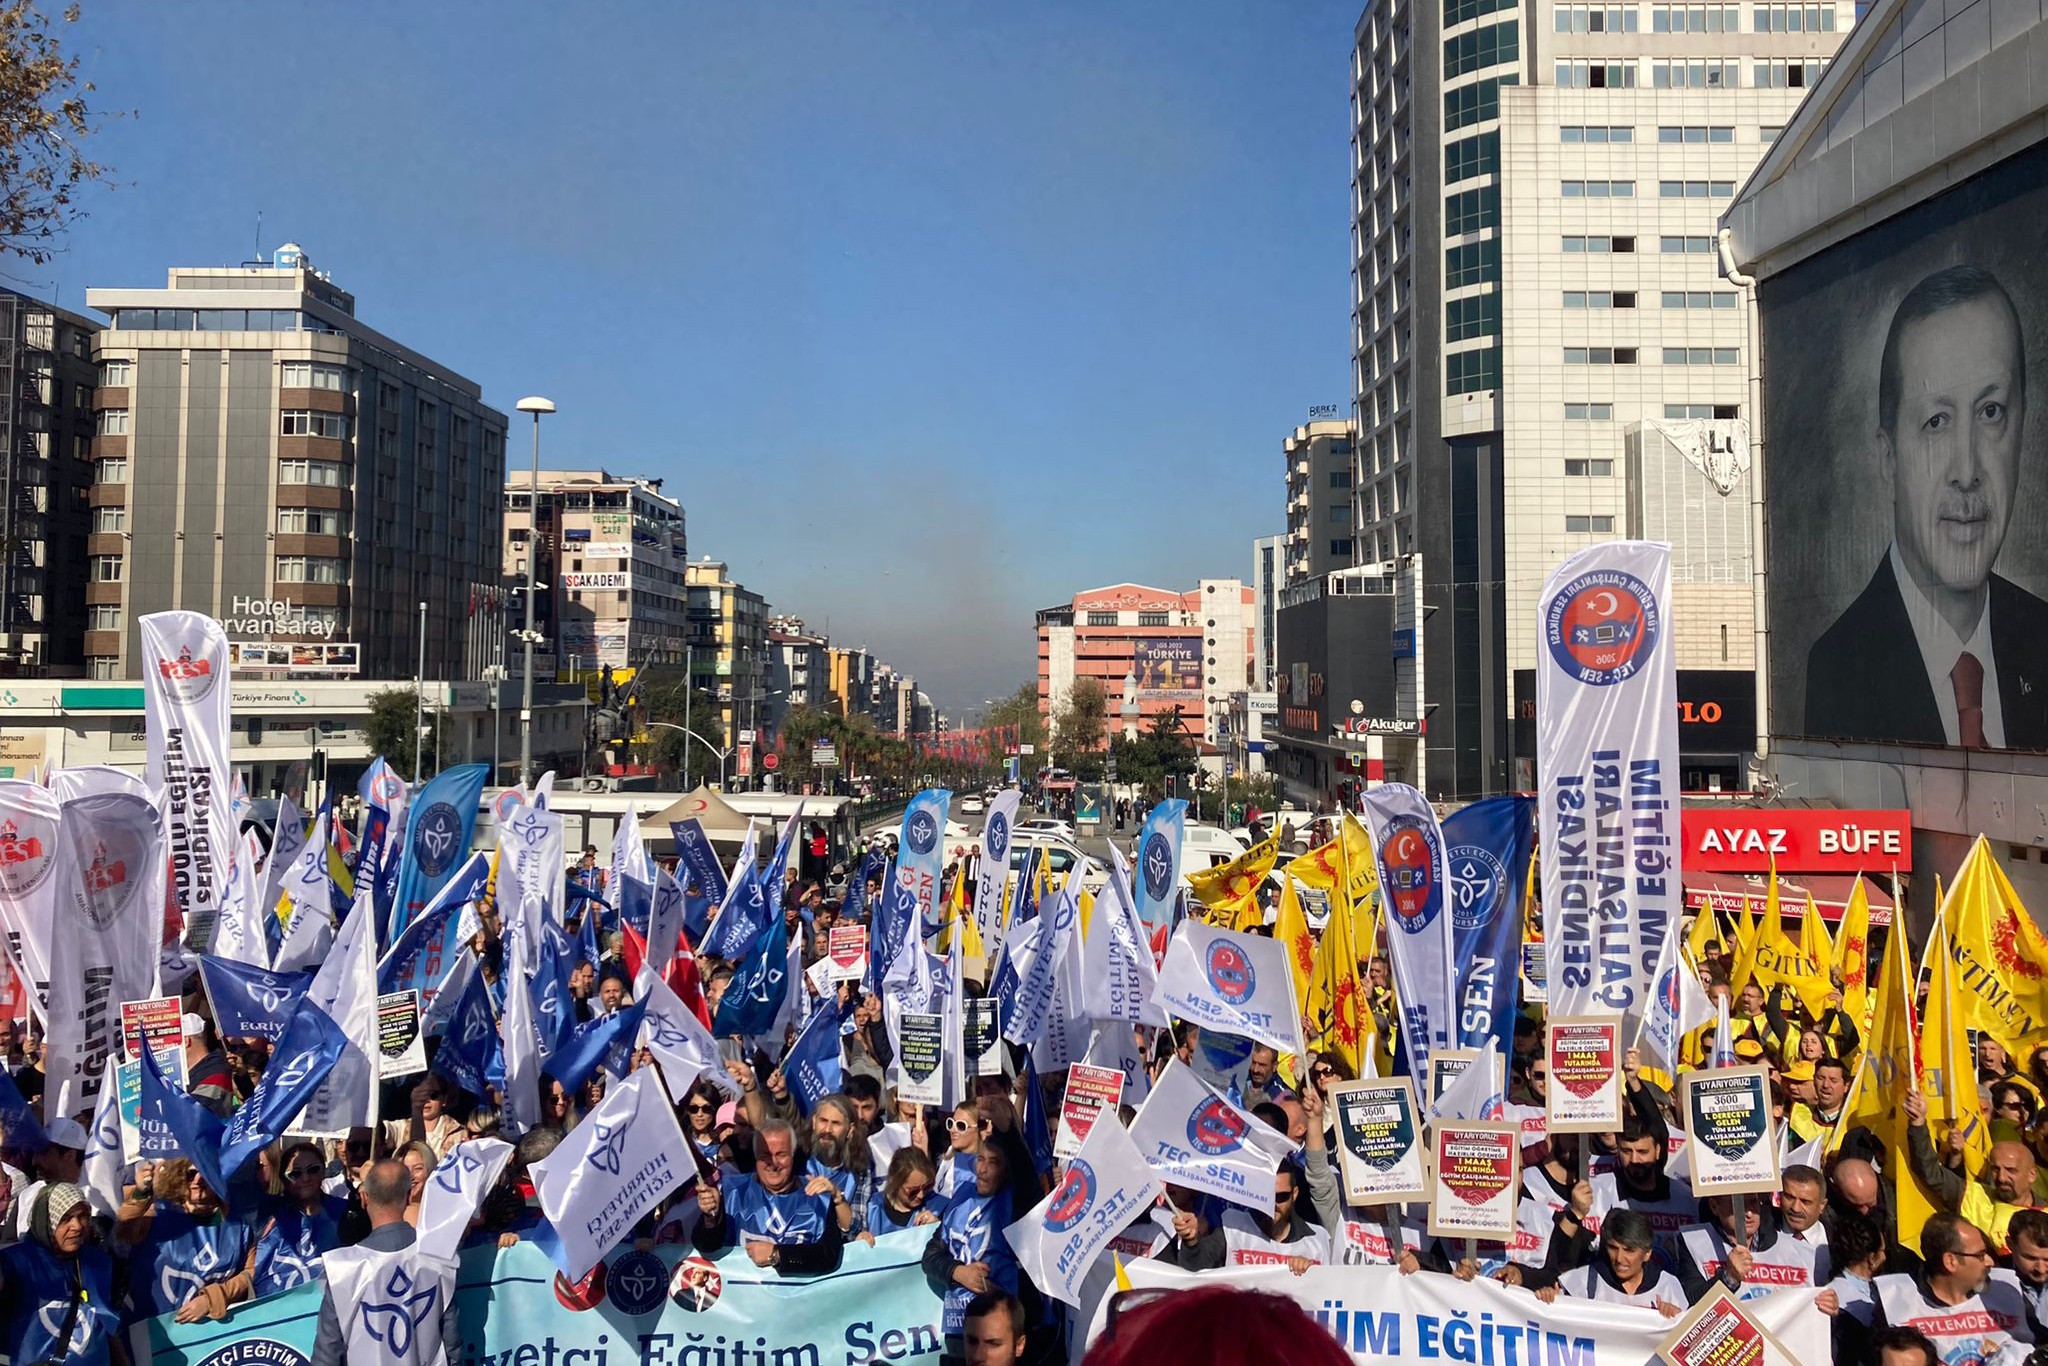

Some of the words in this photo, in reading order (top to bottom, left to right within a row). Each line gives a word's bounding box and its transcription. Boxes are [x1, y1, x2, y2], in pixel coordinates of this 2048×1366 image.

[232, 595, 291, 616] Hotel
[222, 618, 336, 639] rvansaray
[1147, 649, 1192, 660] TÜRKİYE
[232, 694, 262, 704] Türkiye
[1678, 701, 1722, 723] LO
[1369, 718, 1417, 733] Akuğur
[187, 766, 214, 905] SENDİKASI
[1700, 828, 1788, 853] AYAZ
[1818, 824, 1902, 853] BÜFE
[918, 872, 934, 915] SEN
[1461, 954, 1496, 1034] SEN
[74, 966, 114, 1098] EĞİTİM
[1573, 1052, 1598, 1060] MAAŞ
[1700, 1077, 1752, 1090] UYARIYORUZ!
[1345, 1089, 1397, 1102] UYARIYORUZ!
[1714, 1094, 1739, 1106] 3600
[1361, 1106, 1386, 1117] 3600
[1712, 1110, 1751, 1120] DERECEYE
[1361, 1122, 1398, 1131] DERECEYE
[1715, 1118, 1742, 1127] GELEN
[1365, 1130, 1390, 1138] GELEN
[1454, 1132, 1499, 1141] UYARIYORUZ!
[1704, 1131, 1758, 1142] ÇALIŞANLARINA
[1355, 1142, 1406, 1153] ÇALIŞANLARINA
[1464, 1158, 1493, 1167] MAAŞ
[1206, 1163, 1246, 1187] SEN
[1453, 1166, 1497, 1174] TUTARINDA
[637, 1332, 821, 1366] Eğitim
[844, 1319, 943, 1366] Sen
[1415, 1309, 1596, 1366] EĞİTİM
[242, 1341, 299, 1364] EĞİTİM
[1710, 1334, 1736, 1360] MAAŞ
